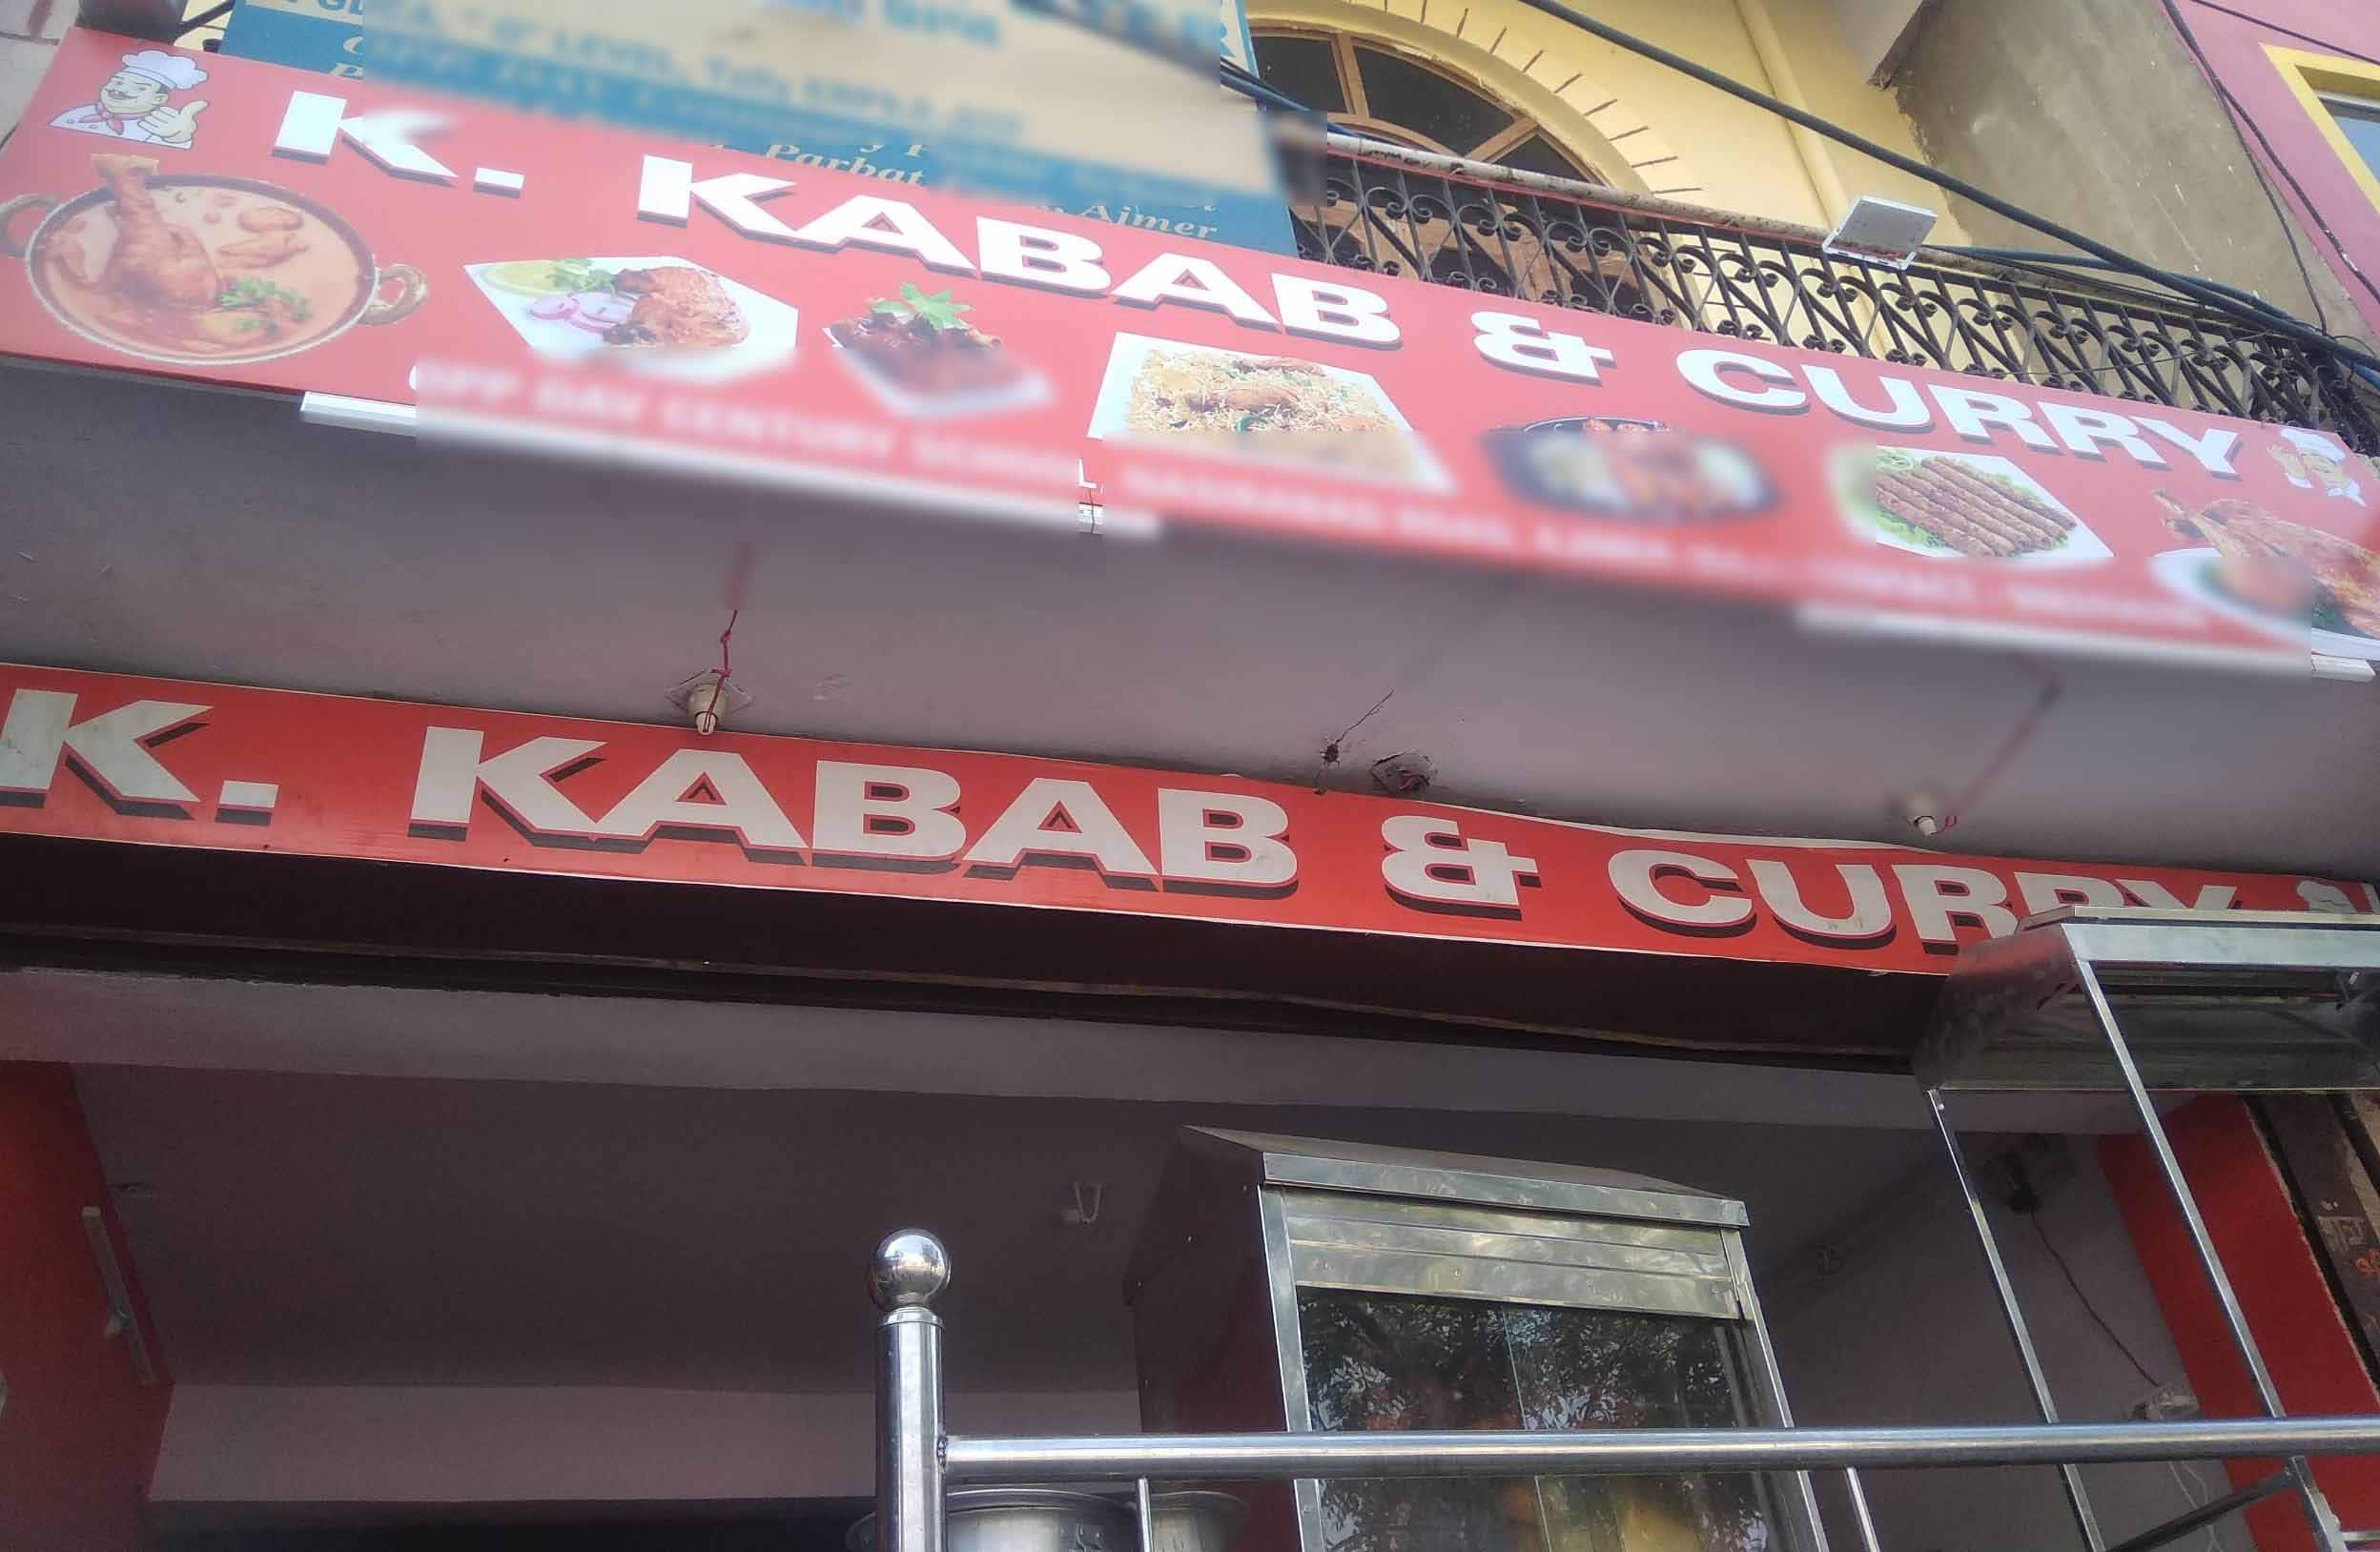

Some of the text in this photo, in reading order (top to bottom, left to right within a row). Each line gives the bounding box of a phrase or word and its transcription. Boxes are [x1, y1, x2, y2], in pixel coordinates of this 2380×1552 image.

[765, 144, 929, 187] Parbat
[272, 90, 526, 194] K.
[637, 153, 1404, 349] KABAB
[1469, 309, 1615, 383] &
[1674, 348, 2242, 479] CURRY
[0, 687, 279, 815] K.
[408, 725, 1299, 892] KABAB
[1380, 813, 1539, 913] &
